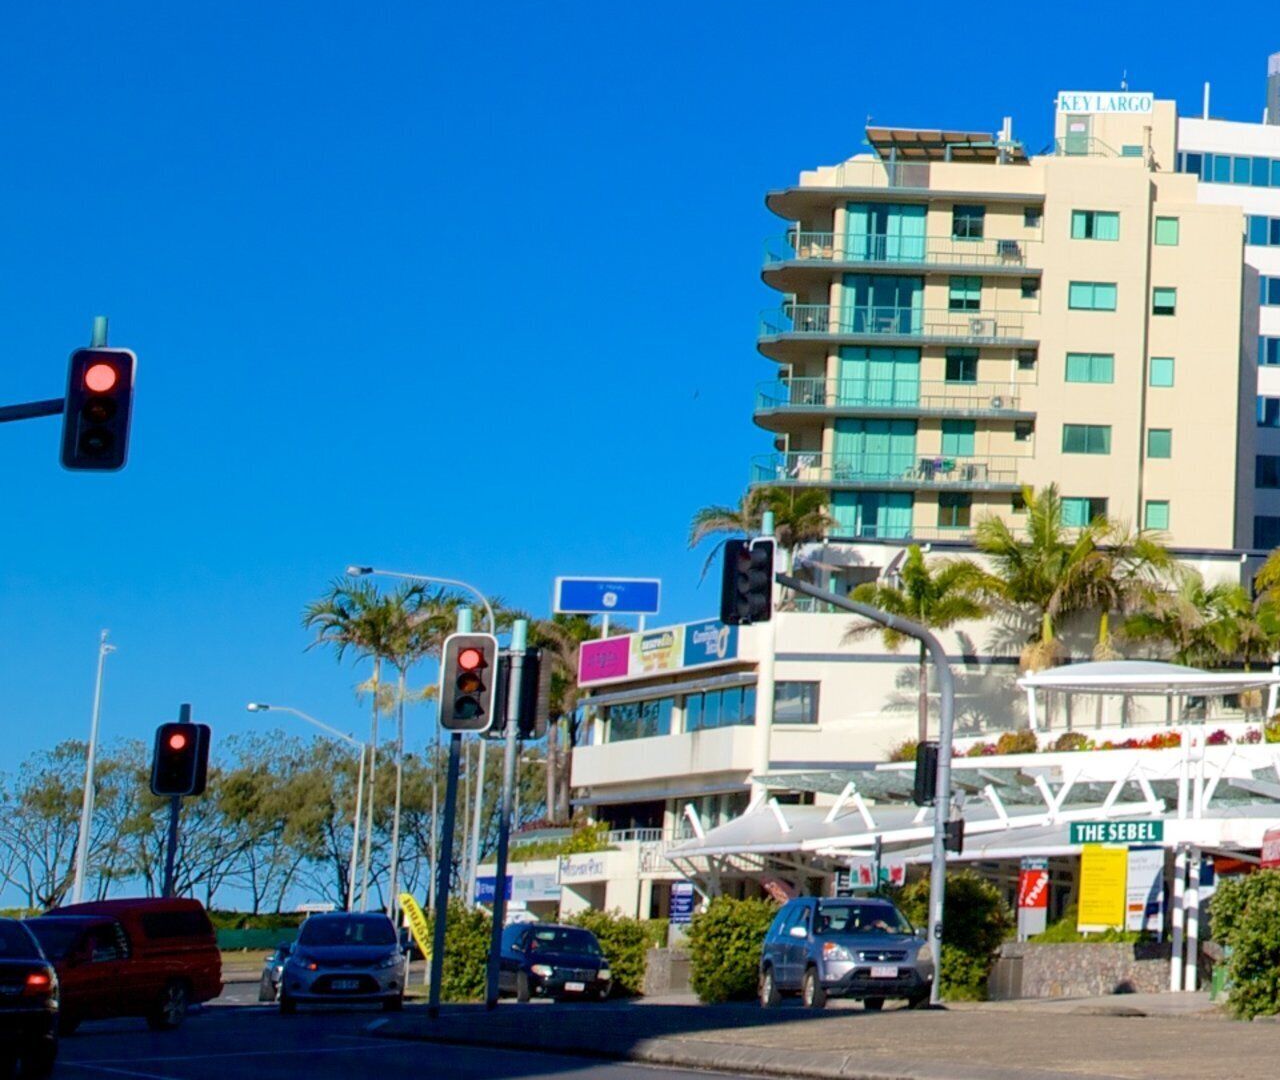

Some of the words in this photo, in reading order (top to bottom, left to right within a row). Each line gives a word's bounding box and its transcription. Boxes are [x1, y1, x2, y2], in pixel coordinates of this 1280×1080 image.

[1060, 94, 1092, 112] KEY
[1096, 94, 1151, 112] LARGO
[1076, 823, 1106, 842] THE
[1108, 822, 1157, 841] SEBEL
